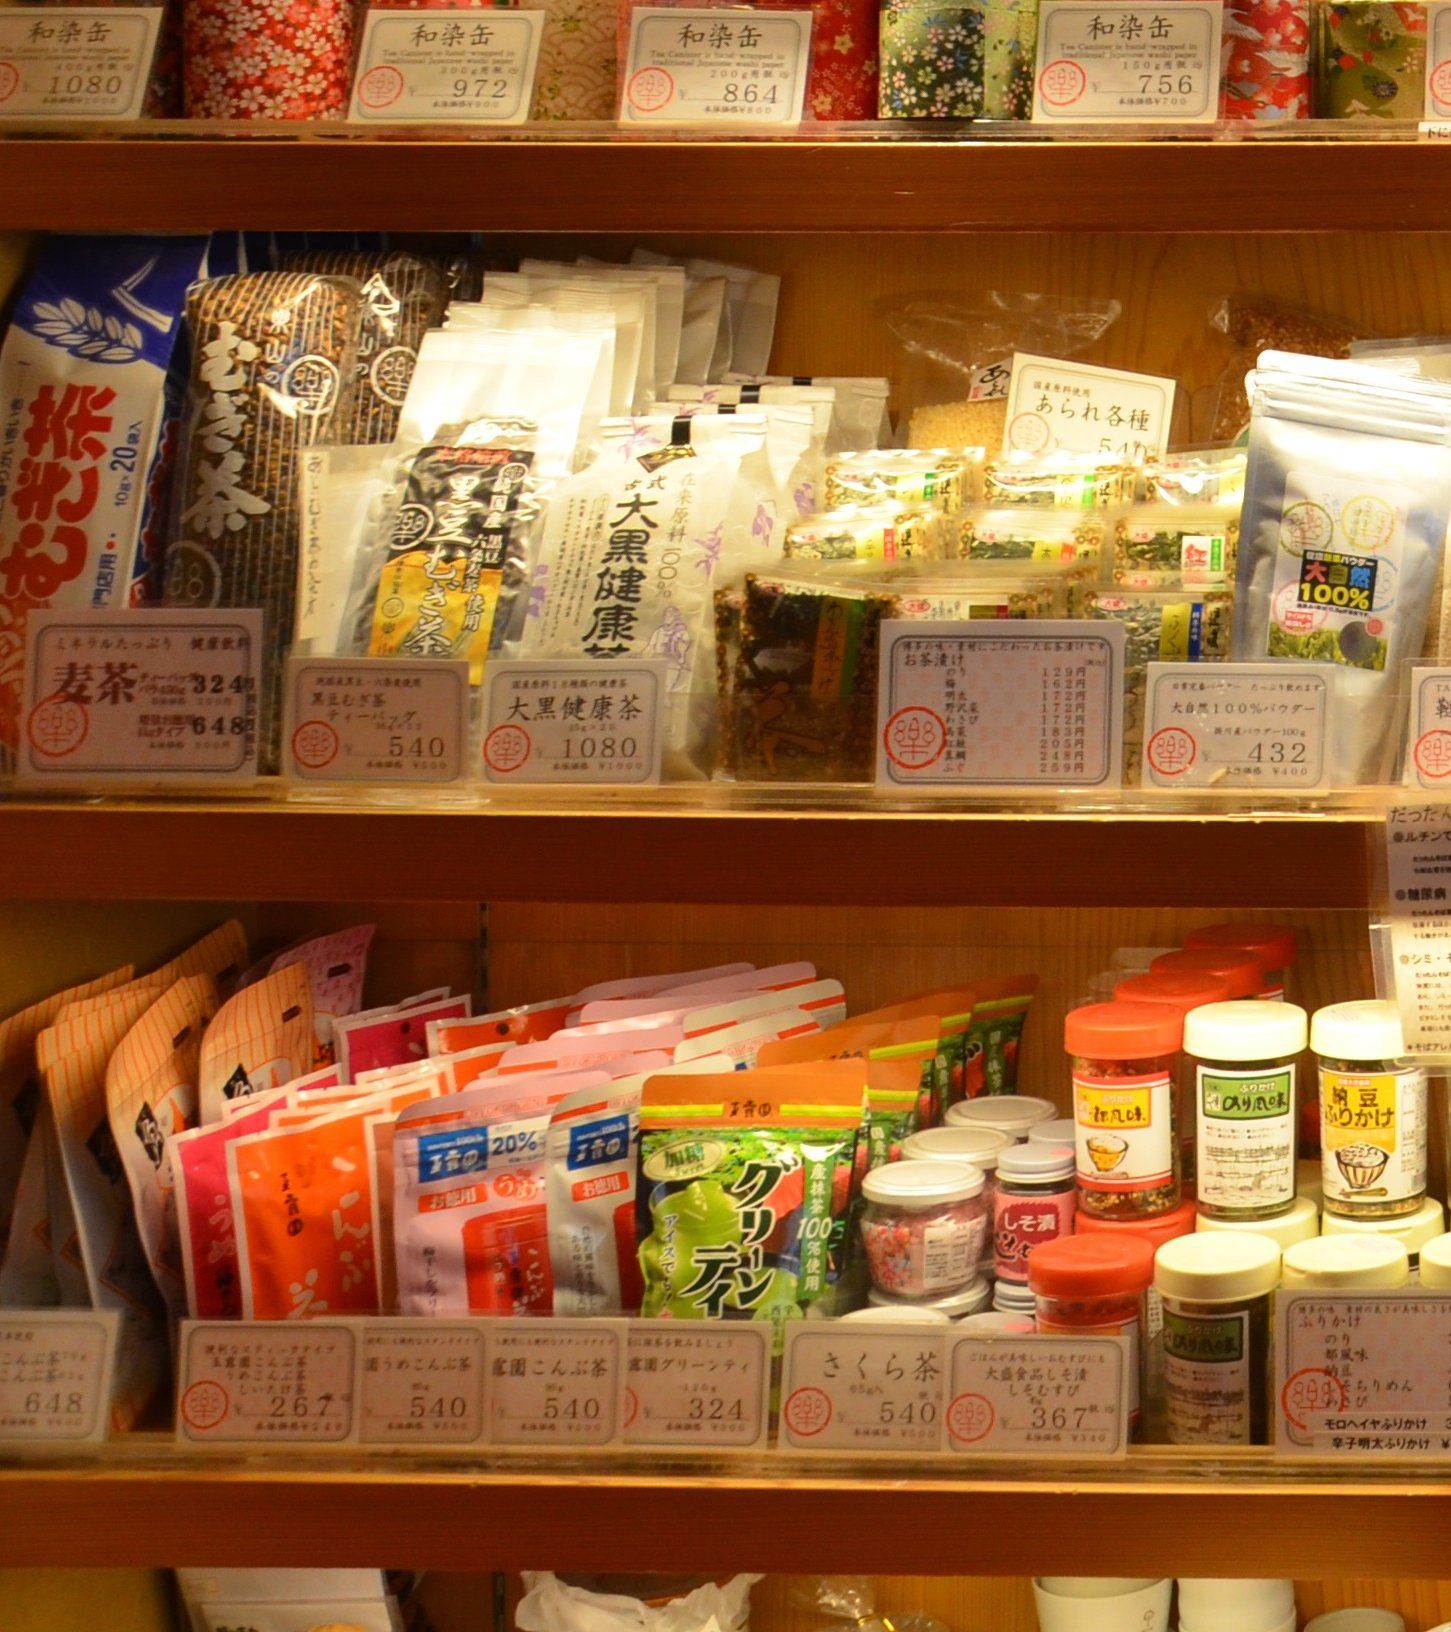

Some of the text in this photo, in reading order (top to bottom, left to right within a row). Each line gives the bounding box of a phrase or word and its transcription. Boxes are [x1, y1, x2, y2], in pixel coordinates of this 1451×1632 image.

[28, 21, 112, 44] 和染缶
[411, 22, 494, 46] 和染缶
[677, 24, 763, 49] 和染缶
[1086, 15, 1174, 40] 和染缶
[49, 75, 122, 95] 1080
[453, 80, 507, 100] 972
[723, 82, 779, 105] 864
[1138, 75, 1193, 94] 756
[1034, 393, 1152, 433] あられ各種
[192, 322, 272, 548] むぎ茶
[404, 476, 477, 657] 黒豆むぎ茶
[1303, 560, 1373, 590] 大自然
[1299, 583, 1371, 611] 100%
[904, 652, 965, 667] お茶漬け
[53, 662, 138, 705] 麦茶
[310, 691, 386, 706] 黒豆むぎ茶
[507, 694, 642, 722] 大黒健康茶
[560, 736, 638, 759] 1080
[1247, 741, 1308, 765] 432
[1221, 1093, 1287, 1114] のり風味
[1331, 1085, 1380, 1108] 納豆
[1324, 1105, 1395, 1128] ふりかけ
[490, 1131, 539, 1157] 20%
[1002, 1213, 1056, 1232] しそ漬
[1298, 1315, 1361, 1330] ふりかけ
[822, 1351, 940, 1382] さくら茶
[1008, 1382, 1081, 1397] しそむすび
[270, 1395, 330, 1418] 267
[689, 1397, 744, 1420] 324
[1032, 1407, 1087, 1429] 367
[1324, 1417, 1427, 1431] モロヘイヤふりかけ
[1331, 1436, 1431, 1451] 辛子明太ふりかけ
